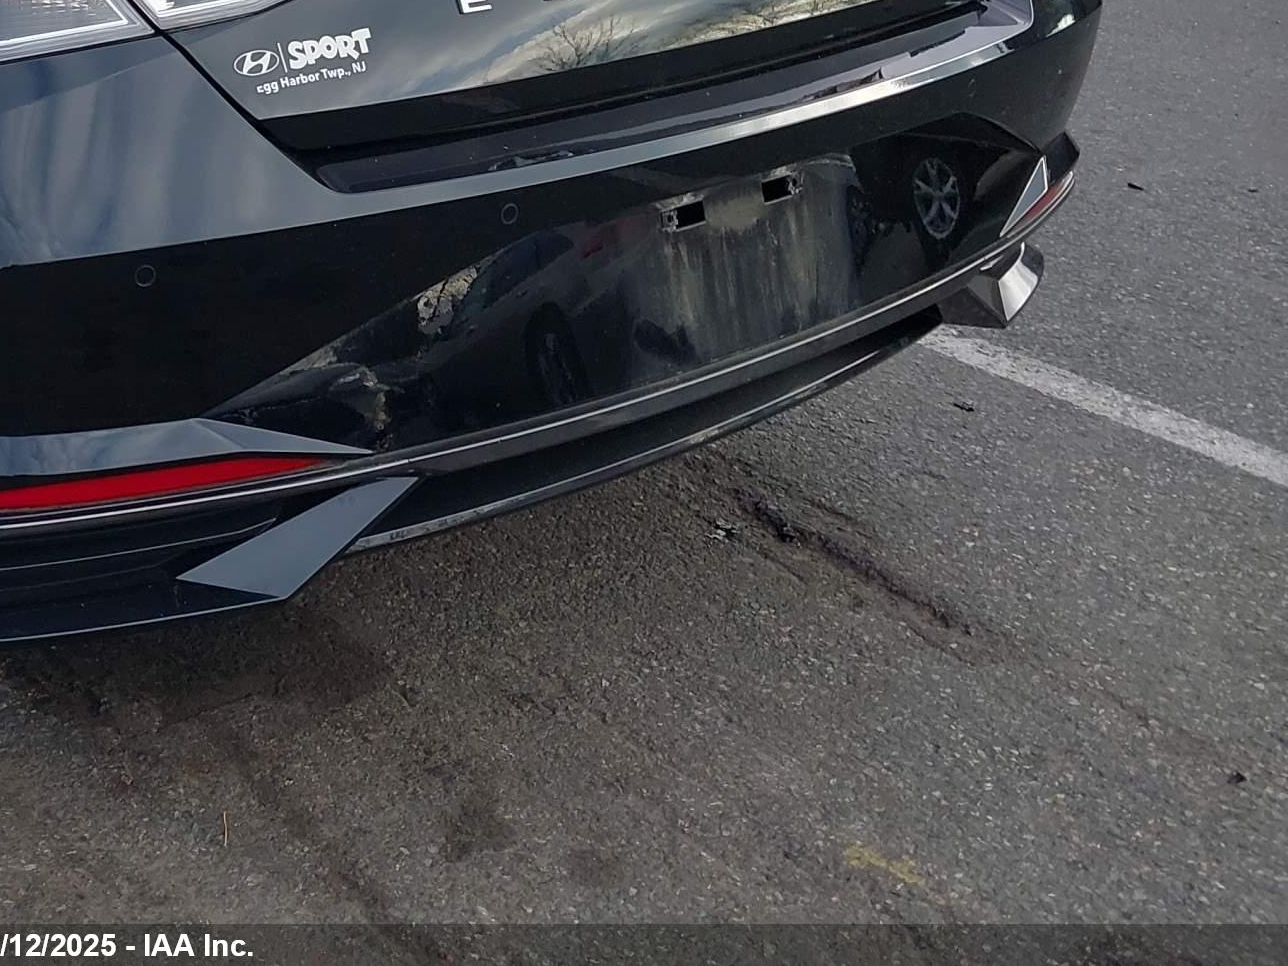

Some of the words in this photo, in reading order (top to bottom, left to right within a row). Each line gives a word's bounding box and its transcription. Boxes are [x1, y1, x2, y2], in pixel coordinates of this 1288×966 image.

[287, 27, 372, 70] SPORT
[280, 72, 321, 89] Harbor
[352, 60, 367, 75] NJ
